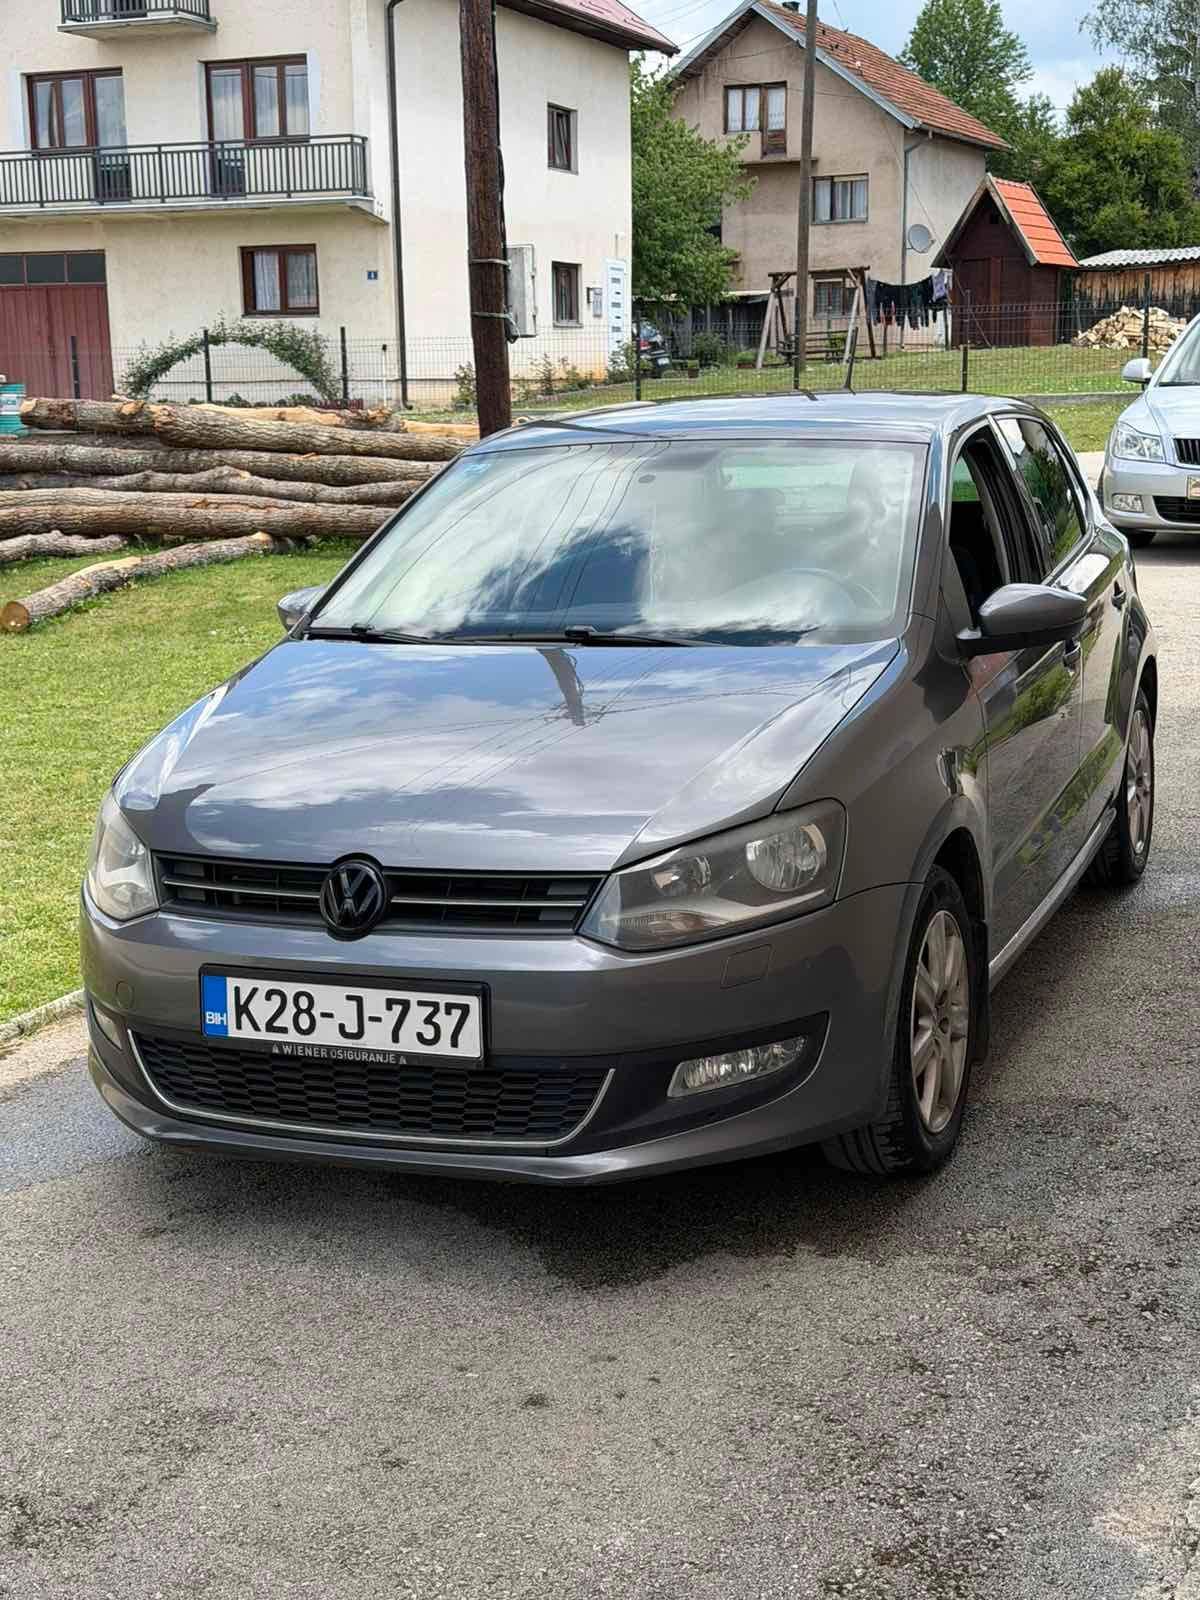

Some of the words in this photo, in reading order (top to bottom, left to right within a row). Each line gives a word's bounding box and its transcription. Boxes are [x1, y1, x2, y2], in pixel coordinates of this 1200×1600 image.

[324, 861, 382, 930] VW
[205, 1011, 227, 1026] BIH
[233, 985, 471, 1048] K28-J-737
[283, 1044, 327, 1059] WIENER
[330, 1050, 396, 1065] OSIGURANJE
